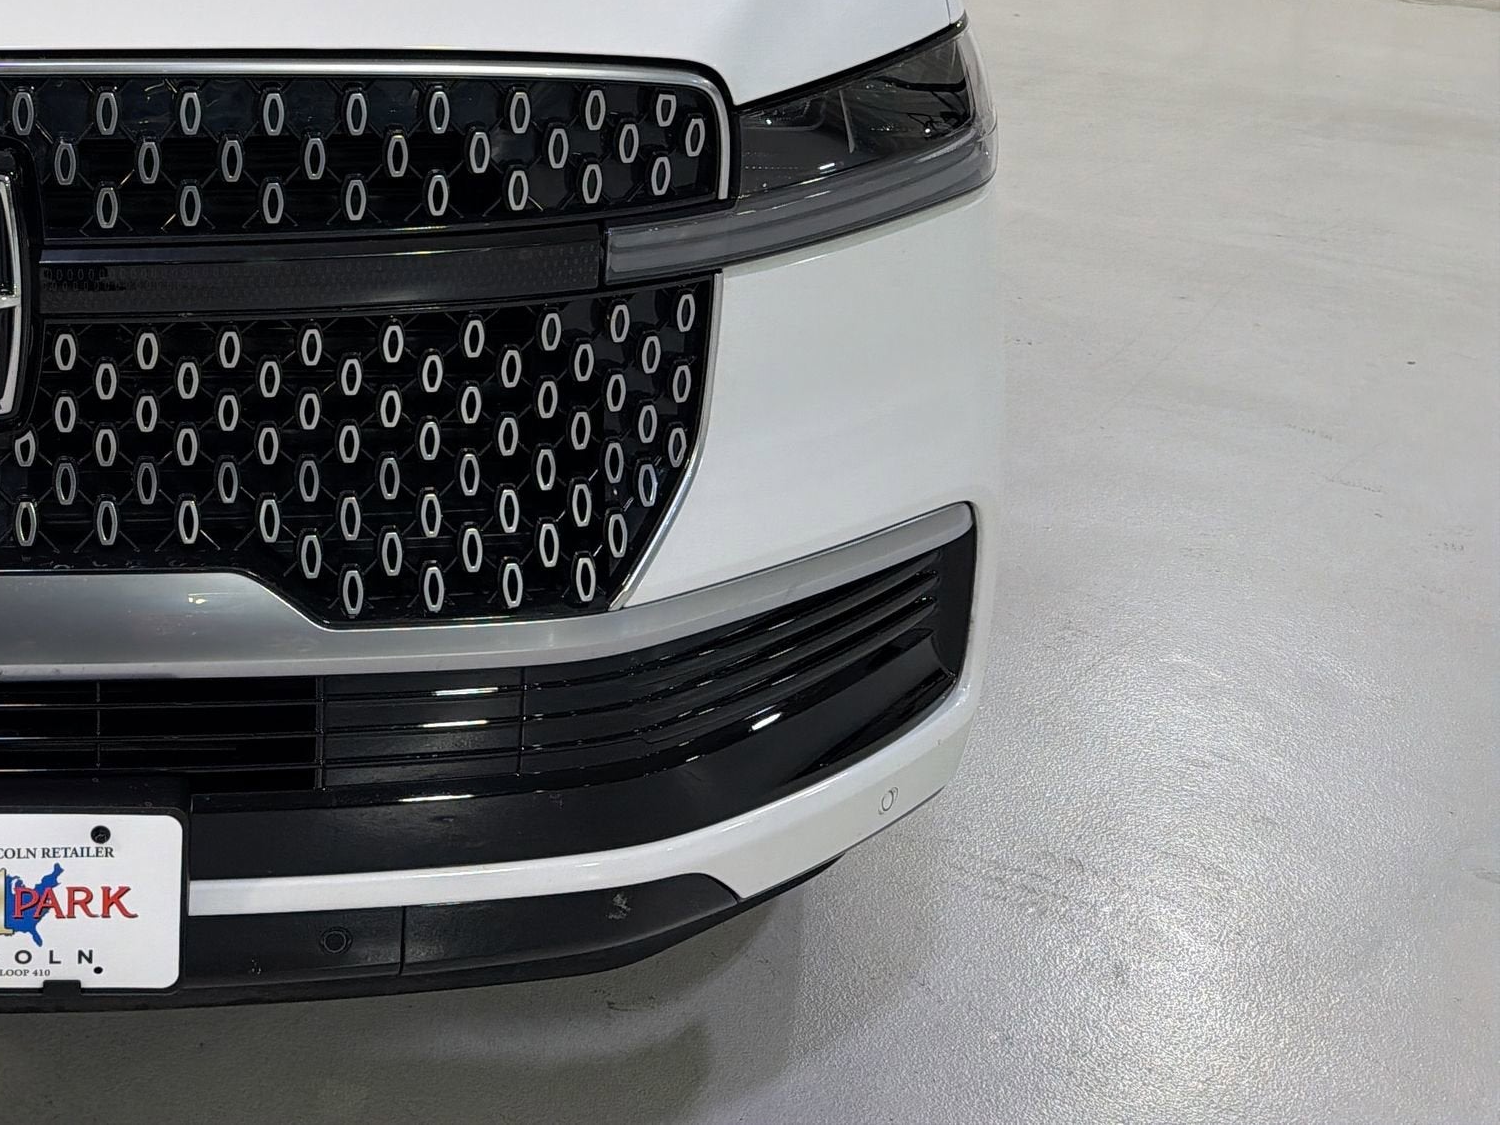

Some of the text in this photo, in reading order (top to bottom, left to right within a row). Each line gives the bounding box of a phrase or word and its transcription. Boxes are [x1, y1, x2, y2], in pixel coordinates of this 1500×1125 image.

[41, 846, 115, 859] RETAILER
[13, 885, 139, 919] PARK
[0, 968, 30, 977] LOOP
[32, 968, 51, 977] 410
